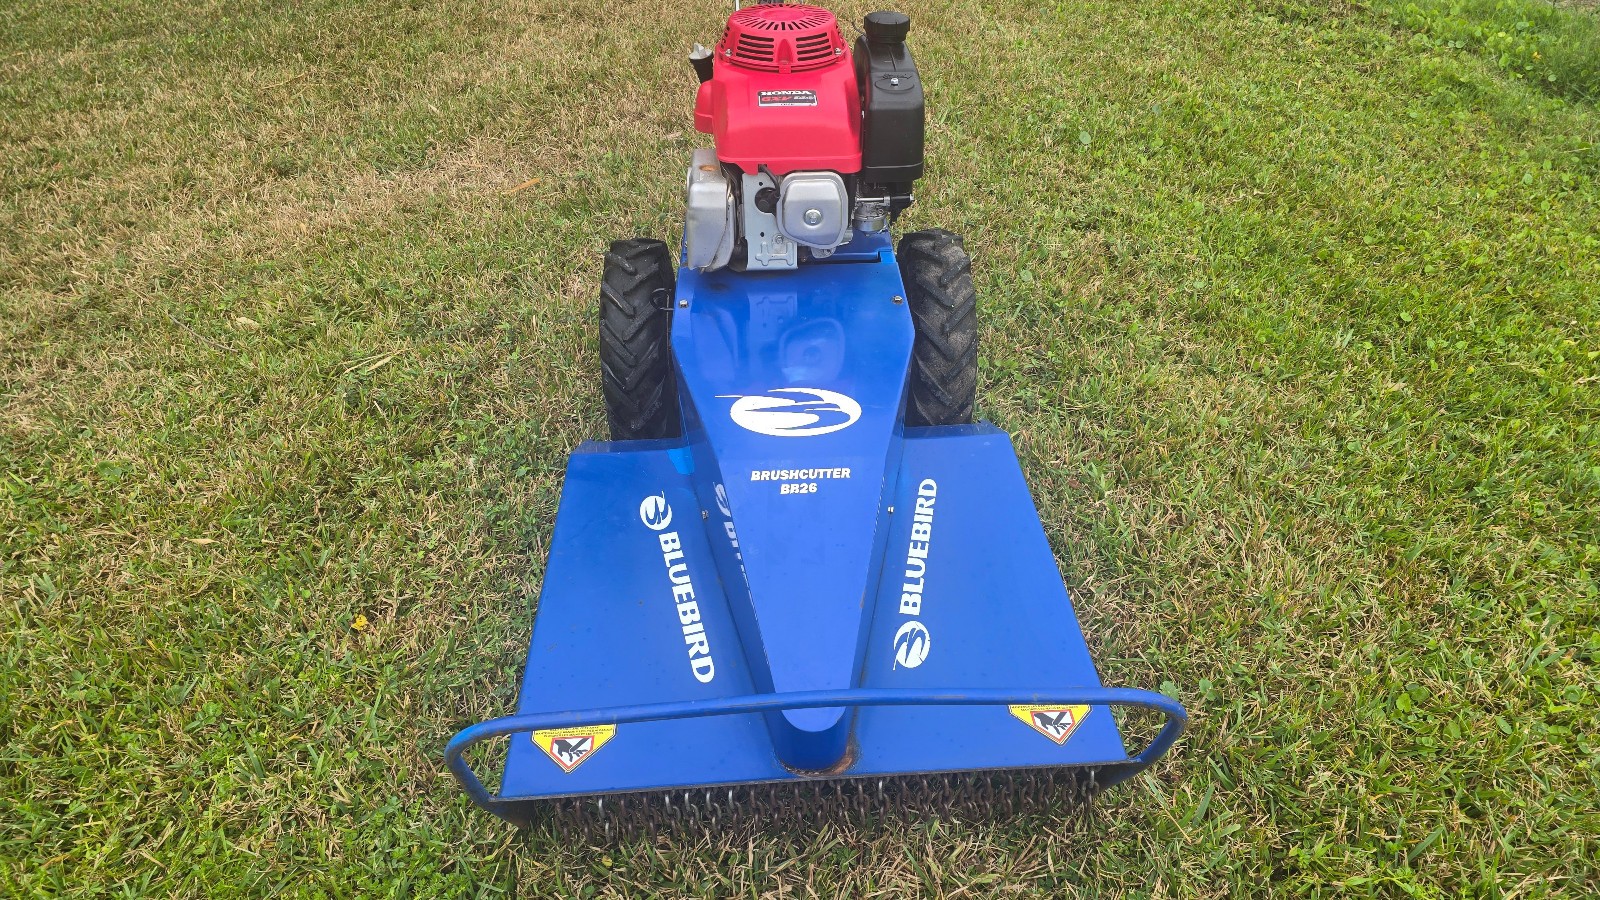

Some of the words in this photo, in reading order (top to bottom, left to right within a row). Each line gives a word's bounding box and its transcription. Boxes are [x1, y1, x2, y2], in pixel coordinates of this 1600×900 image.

[751, 468, 851, 481] BRUSHCUTTER
[780, 482, 818, 495] BR26
[901, 479, 938, 616] BLUEBIRD
[659, 532, 715, 683] BLUEBIRD
